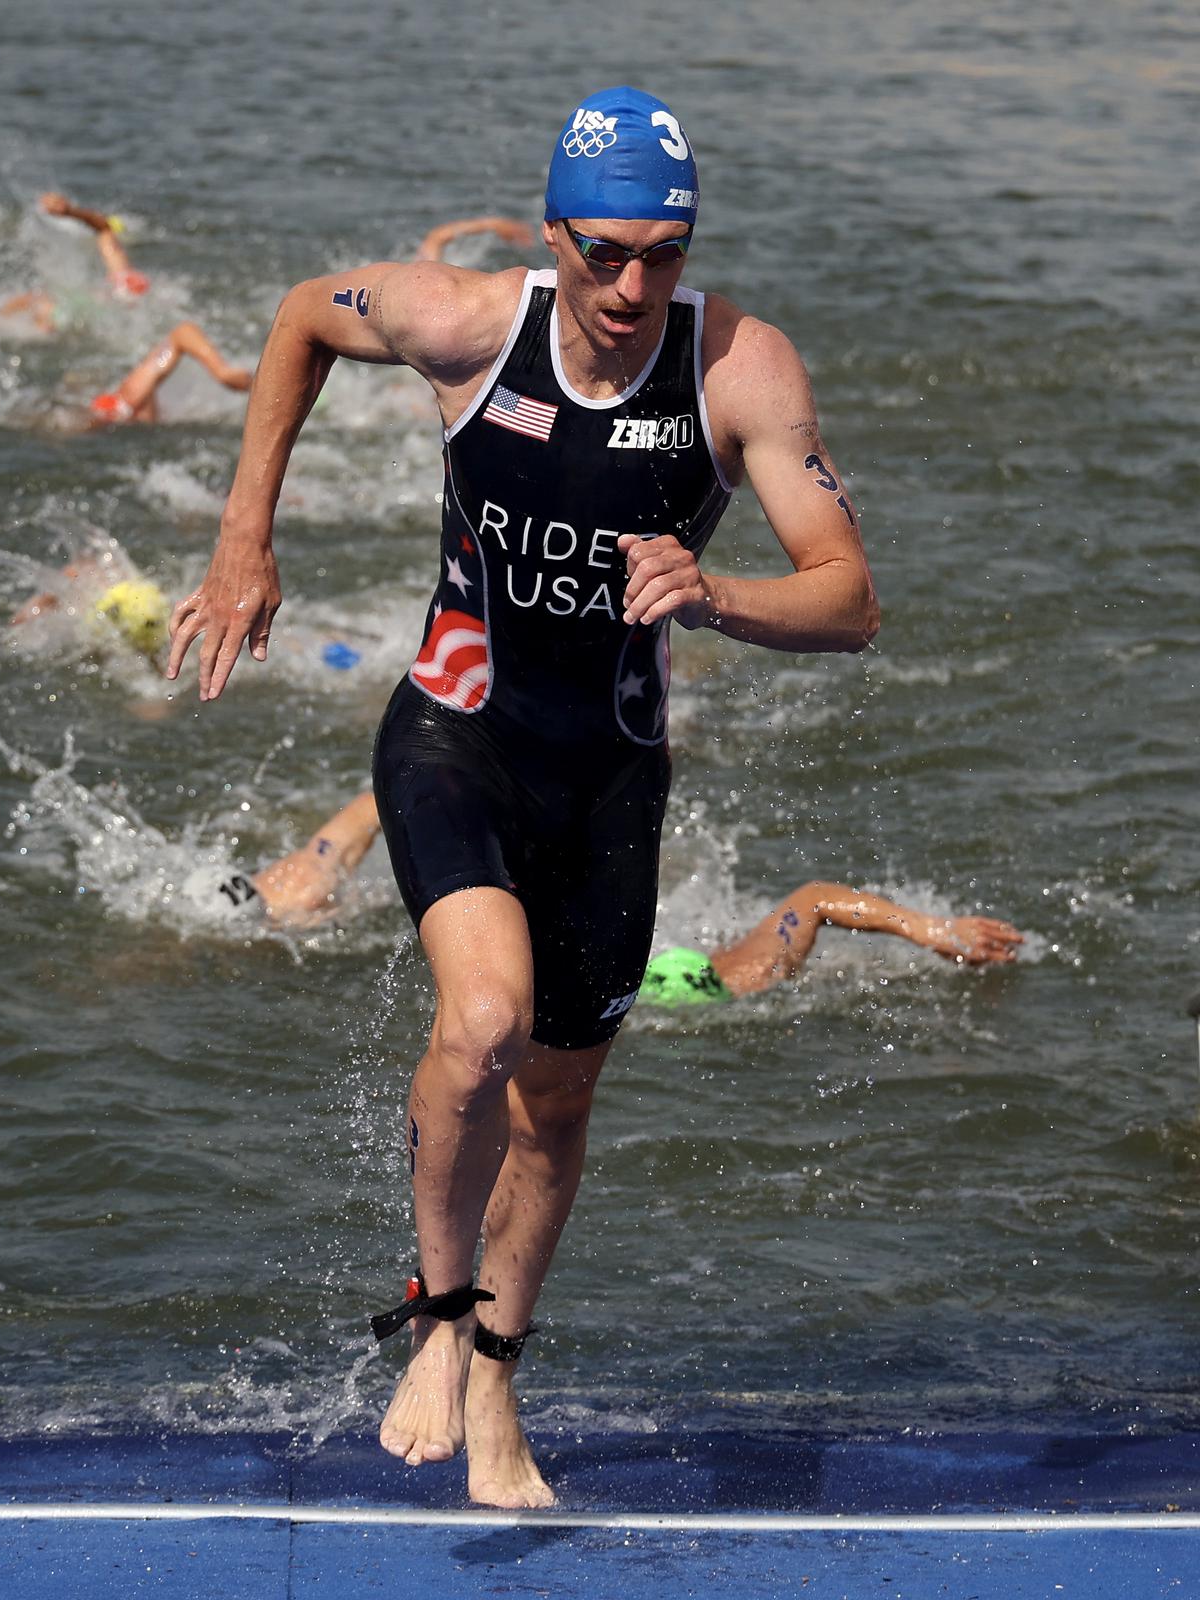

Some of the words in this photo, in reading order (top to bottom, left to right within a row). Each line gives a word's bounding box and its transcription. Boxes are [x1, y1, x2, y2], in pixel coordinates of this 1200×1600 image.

[572, 108, 620, 131] USA
[651, 110, 695, 162] 3
[803, 452, 855, 527] 31
[478, 499, 659, 569] RIDE
[506, 565, 617, 621] USA
[219, 875, 257, 907] 12
